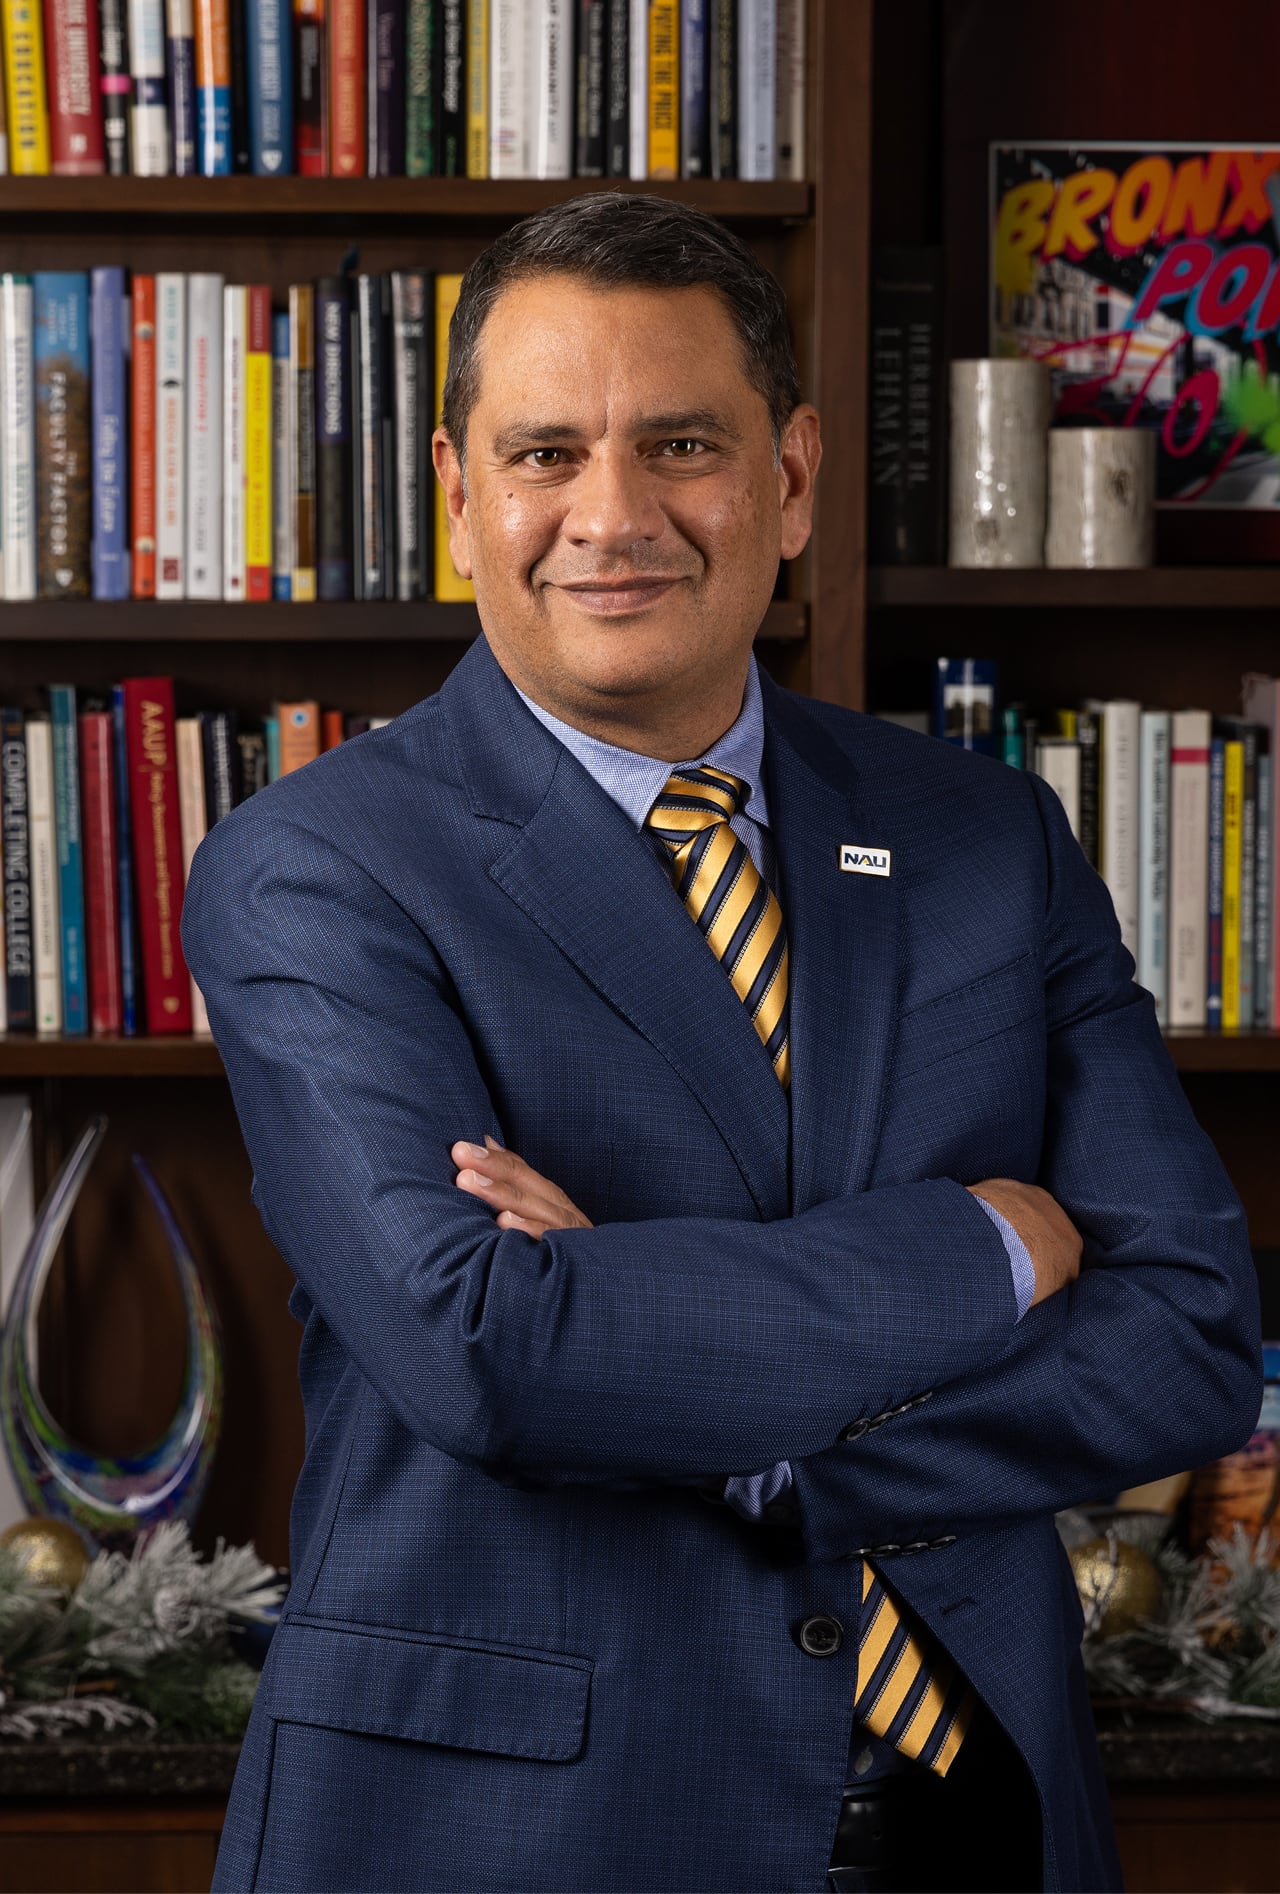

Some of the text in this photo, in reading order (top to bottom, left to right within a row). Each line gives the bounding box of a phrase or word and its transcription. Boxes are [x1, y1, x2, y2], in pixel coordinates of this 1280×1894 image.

[654, 91, 673, 130] PRICE
[995, 151, 1280, 257] BRONX
[324, 301, 342, 435] NEW DIRECTIONS
[874, 326, 902, 487] LEHMAN
[49, 371, 67, 465] FACULTY
[49, 471, 67, 556] FACTOR
[100, 485, 120, 533] Future
[140, 700, 168, 766] AAUP
[3, 741, 31, 977] COMPLETING COLLEGE
[844, 852, 887, 868] NAU
